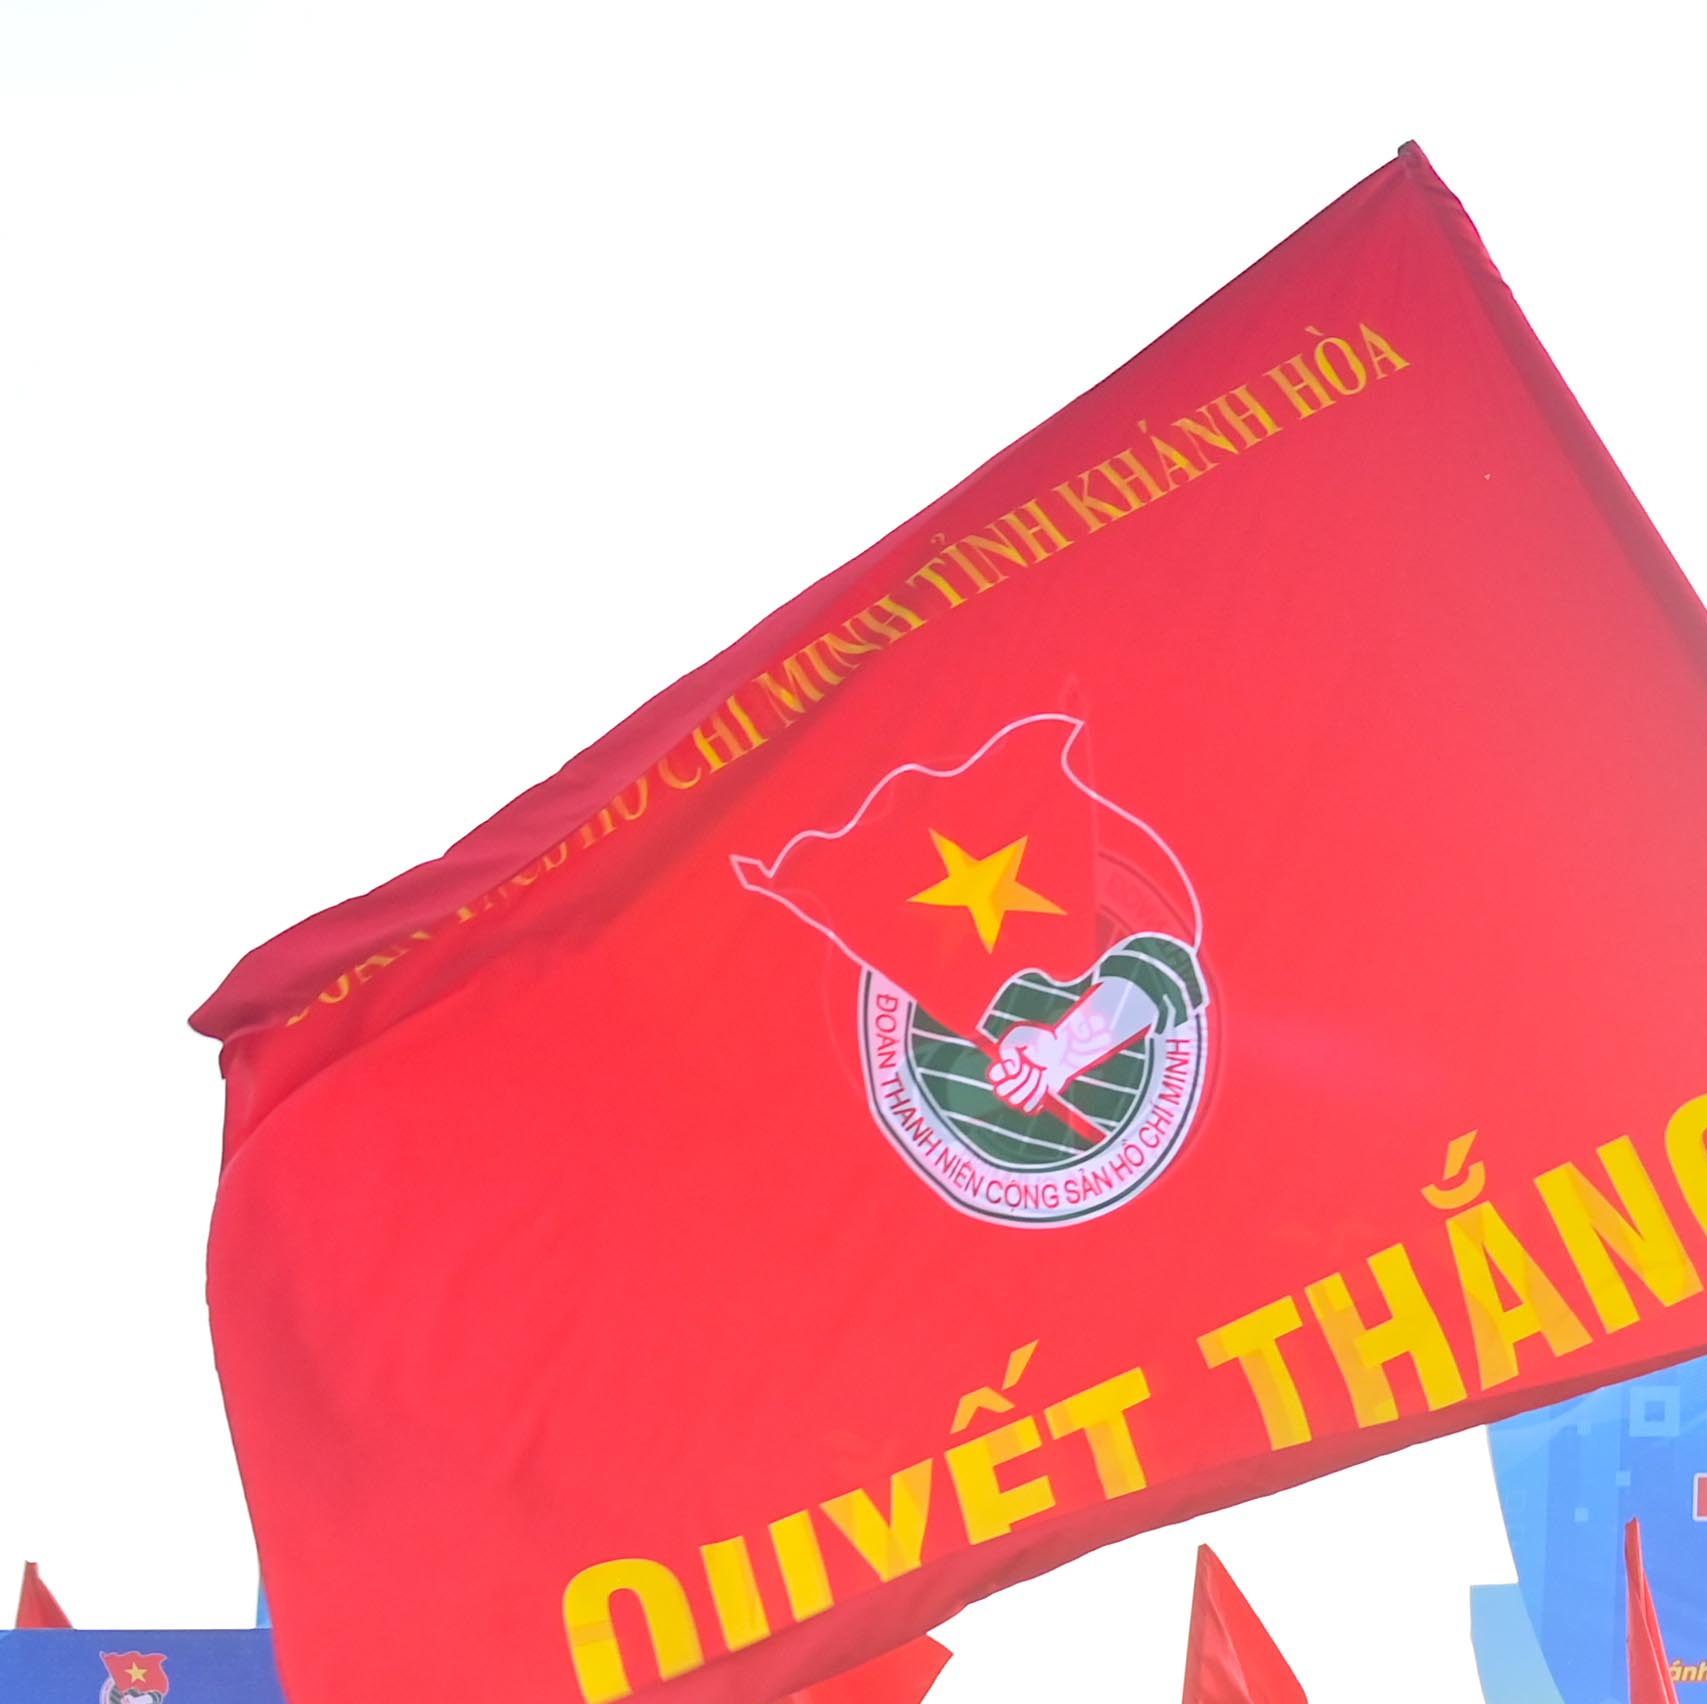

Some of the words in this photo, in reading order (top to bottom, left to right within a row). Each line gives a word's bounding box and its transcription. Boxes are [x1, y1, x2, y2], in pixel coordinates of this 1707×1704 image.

[752, 594, 929, 728] MINH
[905, 499, 1075, 610] TỈNH
[1051, 384, 1284, 534] KHÁNH
[1262, 322, 1412, 420] HÒA
[881, 1071, 943, 1156] THANH
[935, 1147, 985, 1197] NIÊN
[985, 1179, 1060, 1213] CỘNG
[1064, 1166, 1113, 1204] SẢN
[1158, 1039, 1191, 1105] MINH
